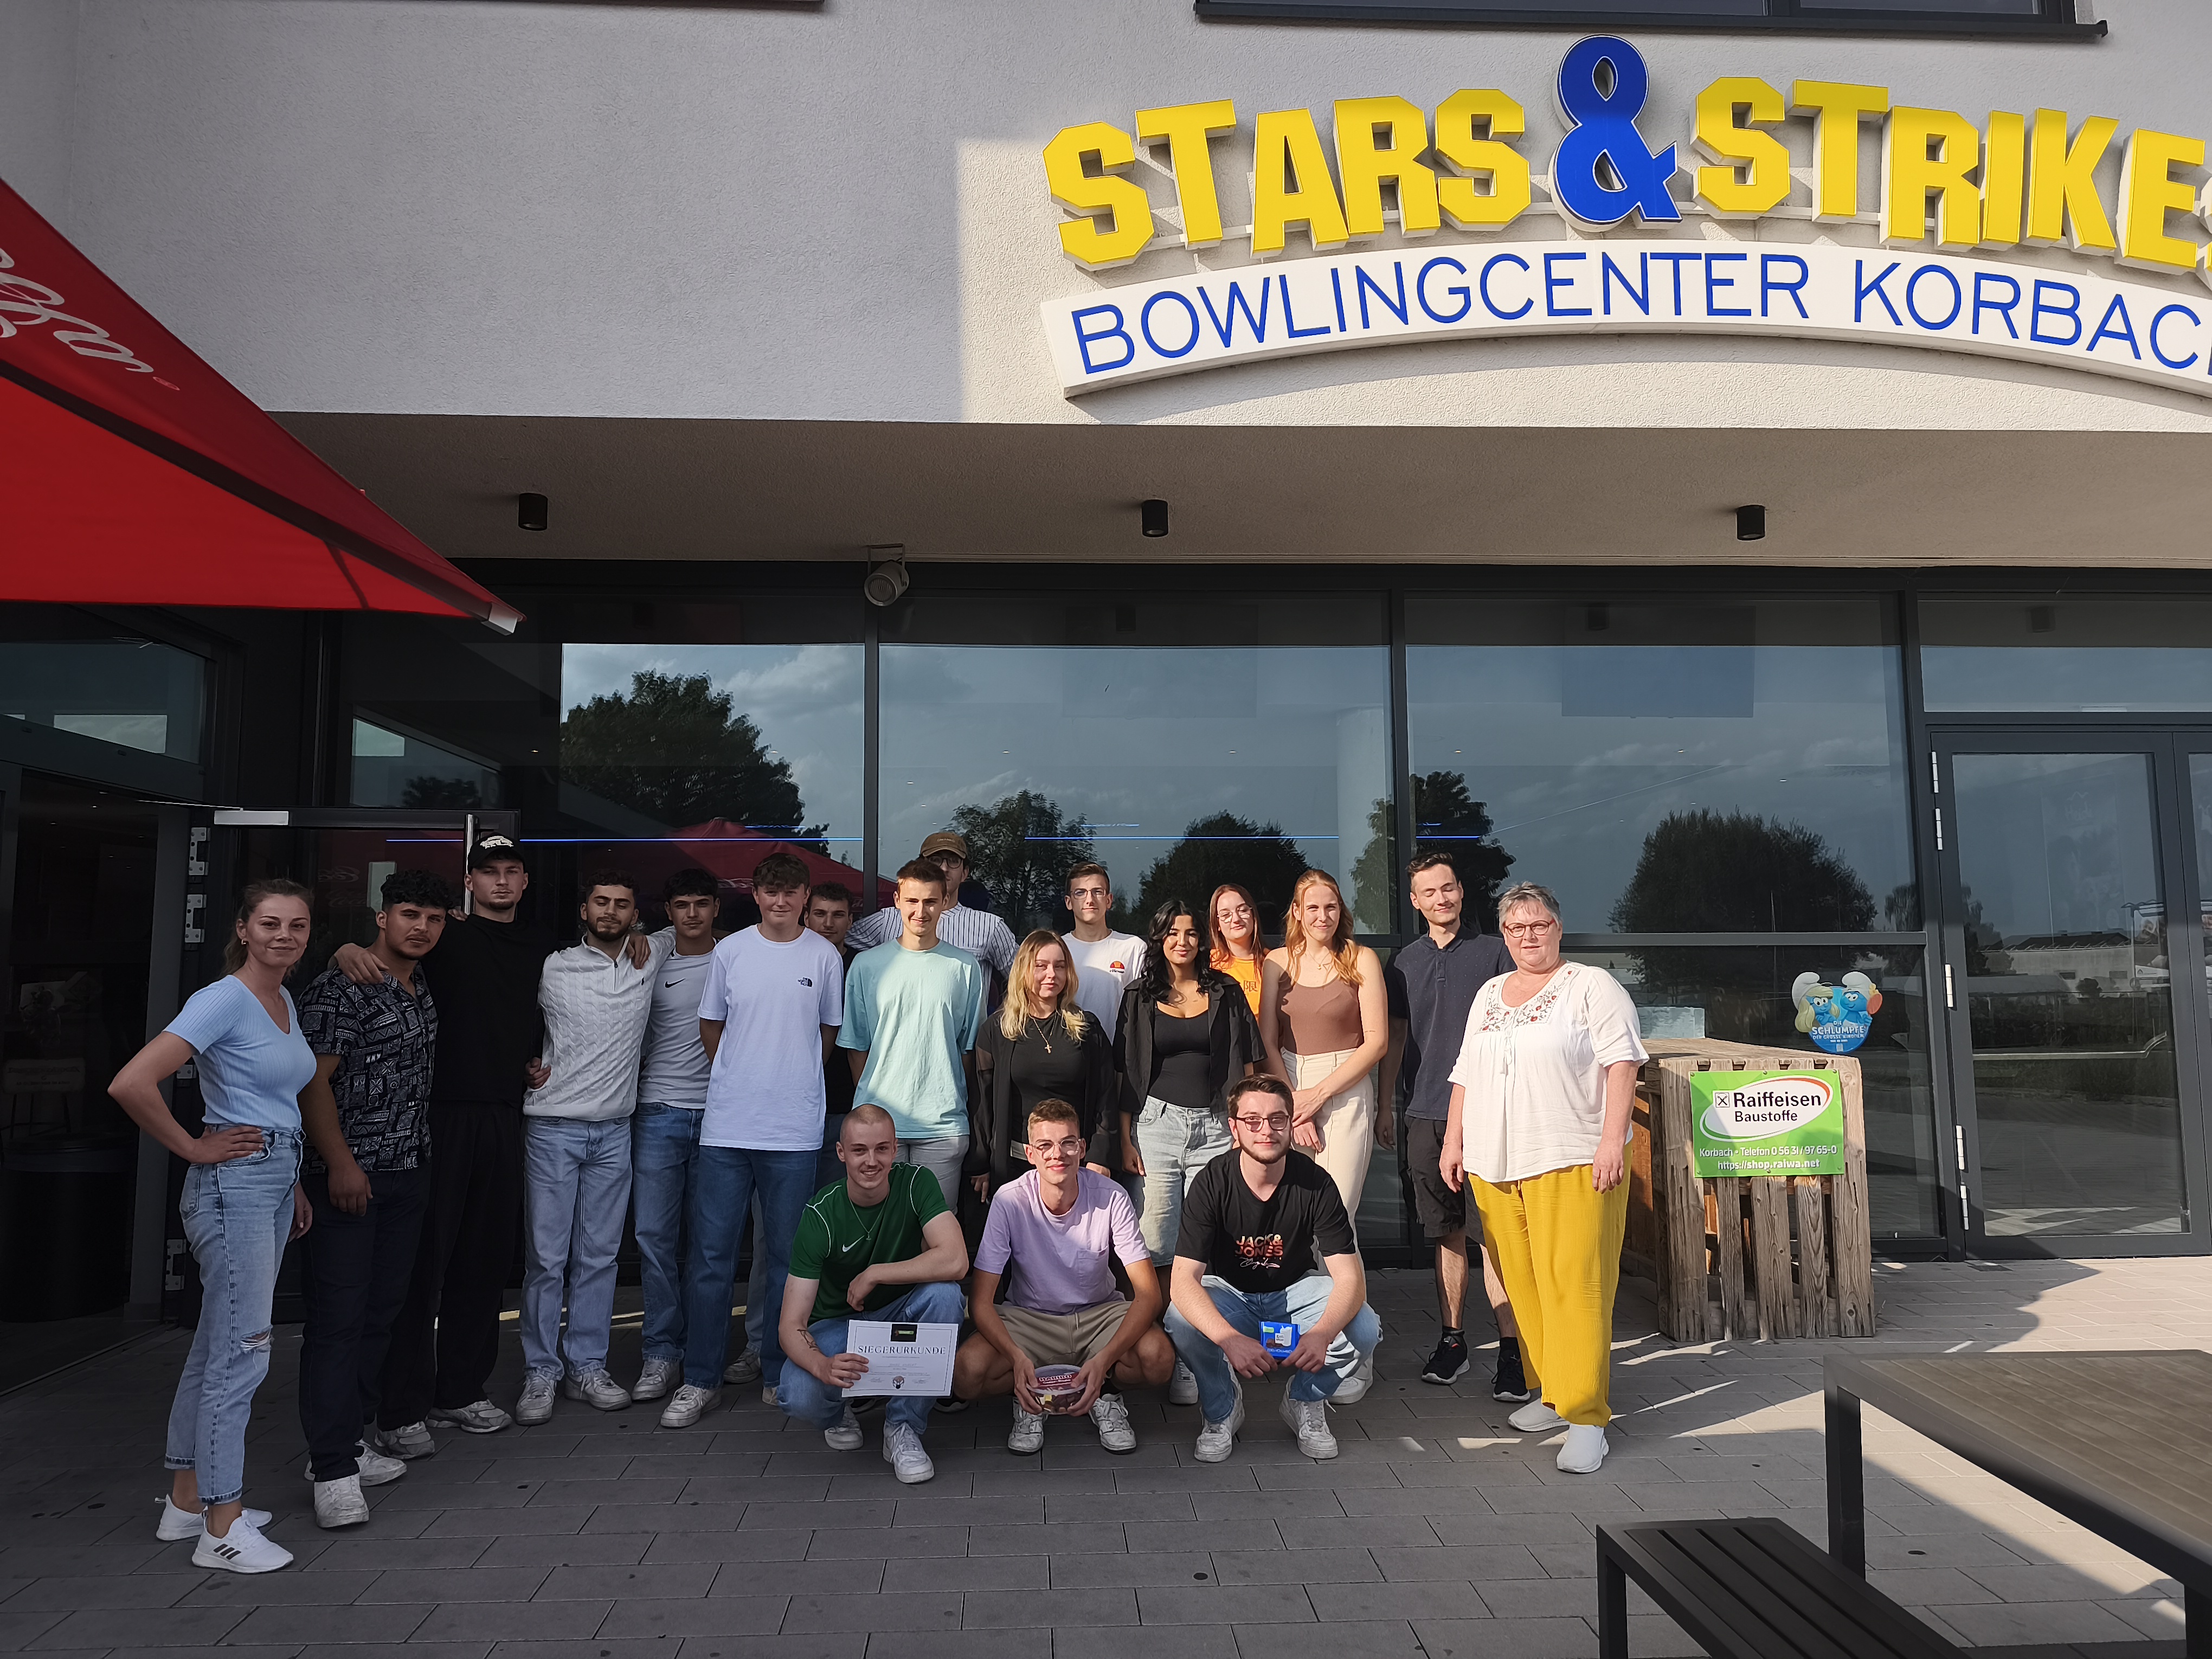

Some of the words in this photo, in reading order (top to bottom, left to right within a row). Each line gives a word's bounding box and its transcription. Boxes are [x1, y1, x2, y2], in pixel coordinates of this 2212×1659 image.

[1042, 88, 1531, 267] STARS
[1549, 34, 1682, 227] &
[1693, 77, 2212, 272] STRIKE
[1071, 252, 1809, 375] BOWLINGCENTER
[1854, 259, 2212, 376] KORBAC
[1733, 1091, 1821, 1108] Raiffeisen
[1734, 1110, 1798, 1122] Baustoffe
[1700, 1147, 1733, 1157] Korbach
[1740, 1147, 1770, 1156] Telefon
[1771, 1147, 1777, 1155] 0
[1805, 1146, 1815, 1155] 97
[1817, 1145, 1837, 1155] 65-0
[1718, 1159, 1820, 1171] https://shop.raiwa.net
[1235, 1245, 1283, 1257] JONES
[858, 1345, 946, 1355] SIEGERURKUNDE
